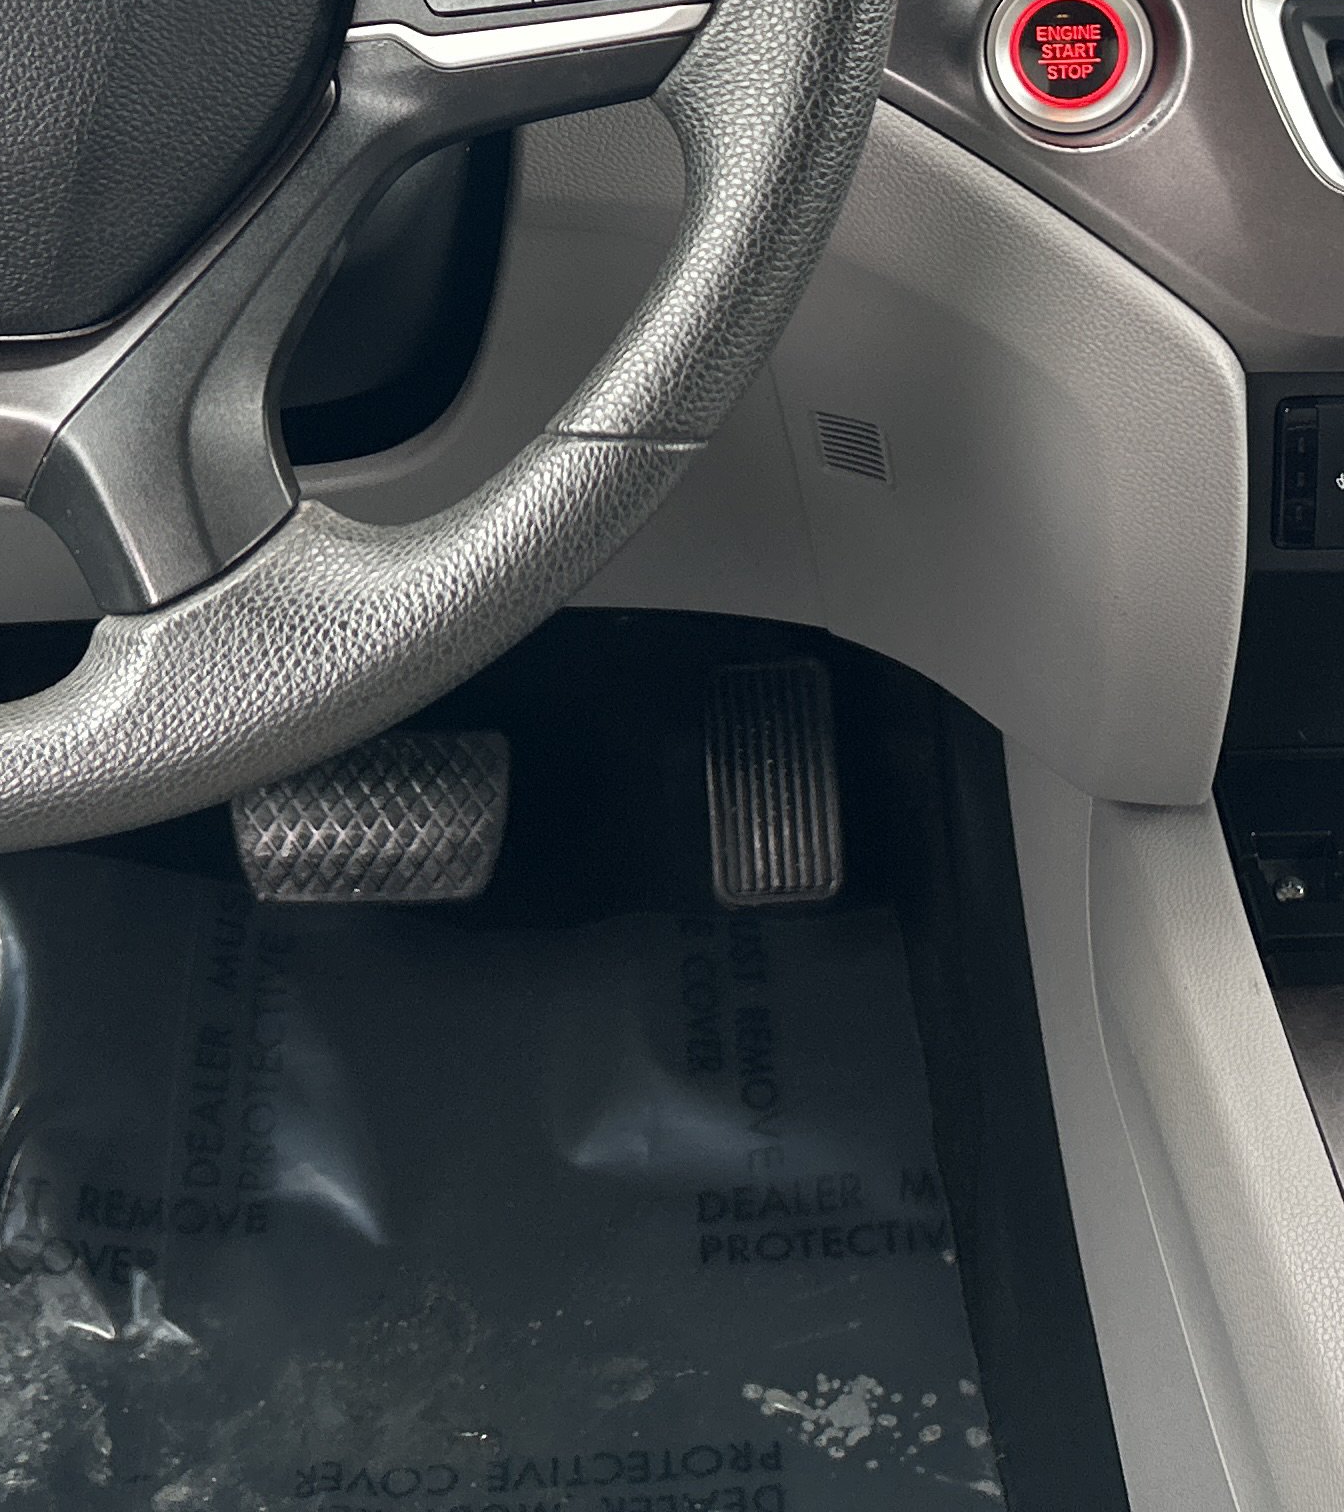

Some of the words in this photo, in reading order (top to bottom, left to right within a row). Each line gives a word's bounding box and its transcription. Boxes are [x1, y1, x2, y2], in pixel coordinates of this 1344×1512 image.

[1036, 24, 1102, 41] ENGINE
[1041, 42, 1097, 59] START
[1046, 64, 1094, 80] STOP
[205, 890, 253, 994] MUS
[681, 955, 724, 1076] COVER
[238, 929, 297, 1194] PROTECTIVE
[181, 1023, 233, 1188] DEALER
[734, 1005, 785, 1174] REMOVE
[76, 1183, 273, 1238] REMOVE
[696, 1171, 863, 1226] DEALER
[699, 1218, 949, 1265] PROTECTIV
[293, 1460, 460, 1499] COVER
[485, 1440, 784, 1494] PROTECTIVE
